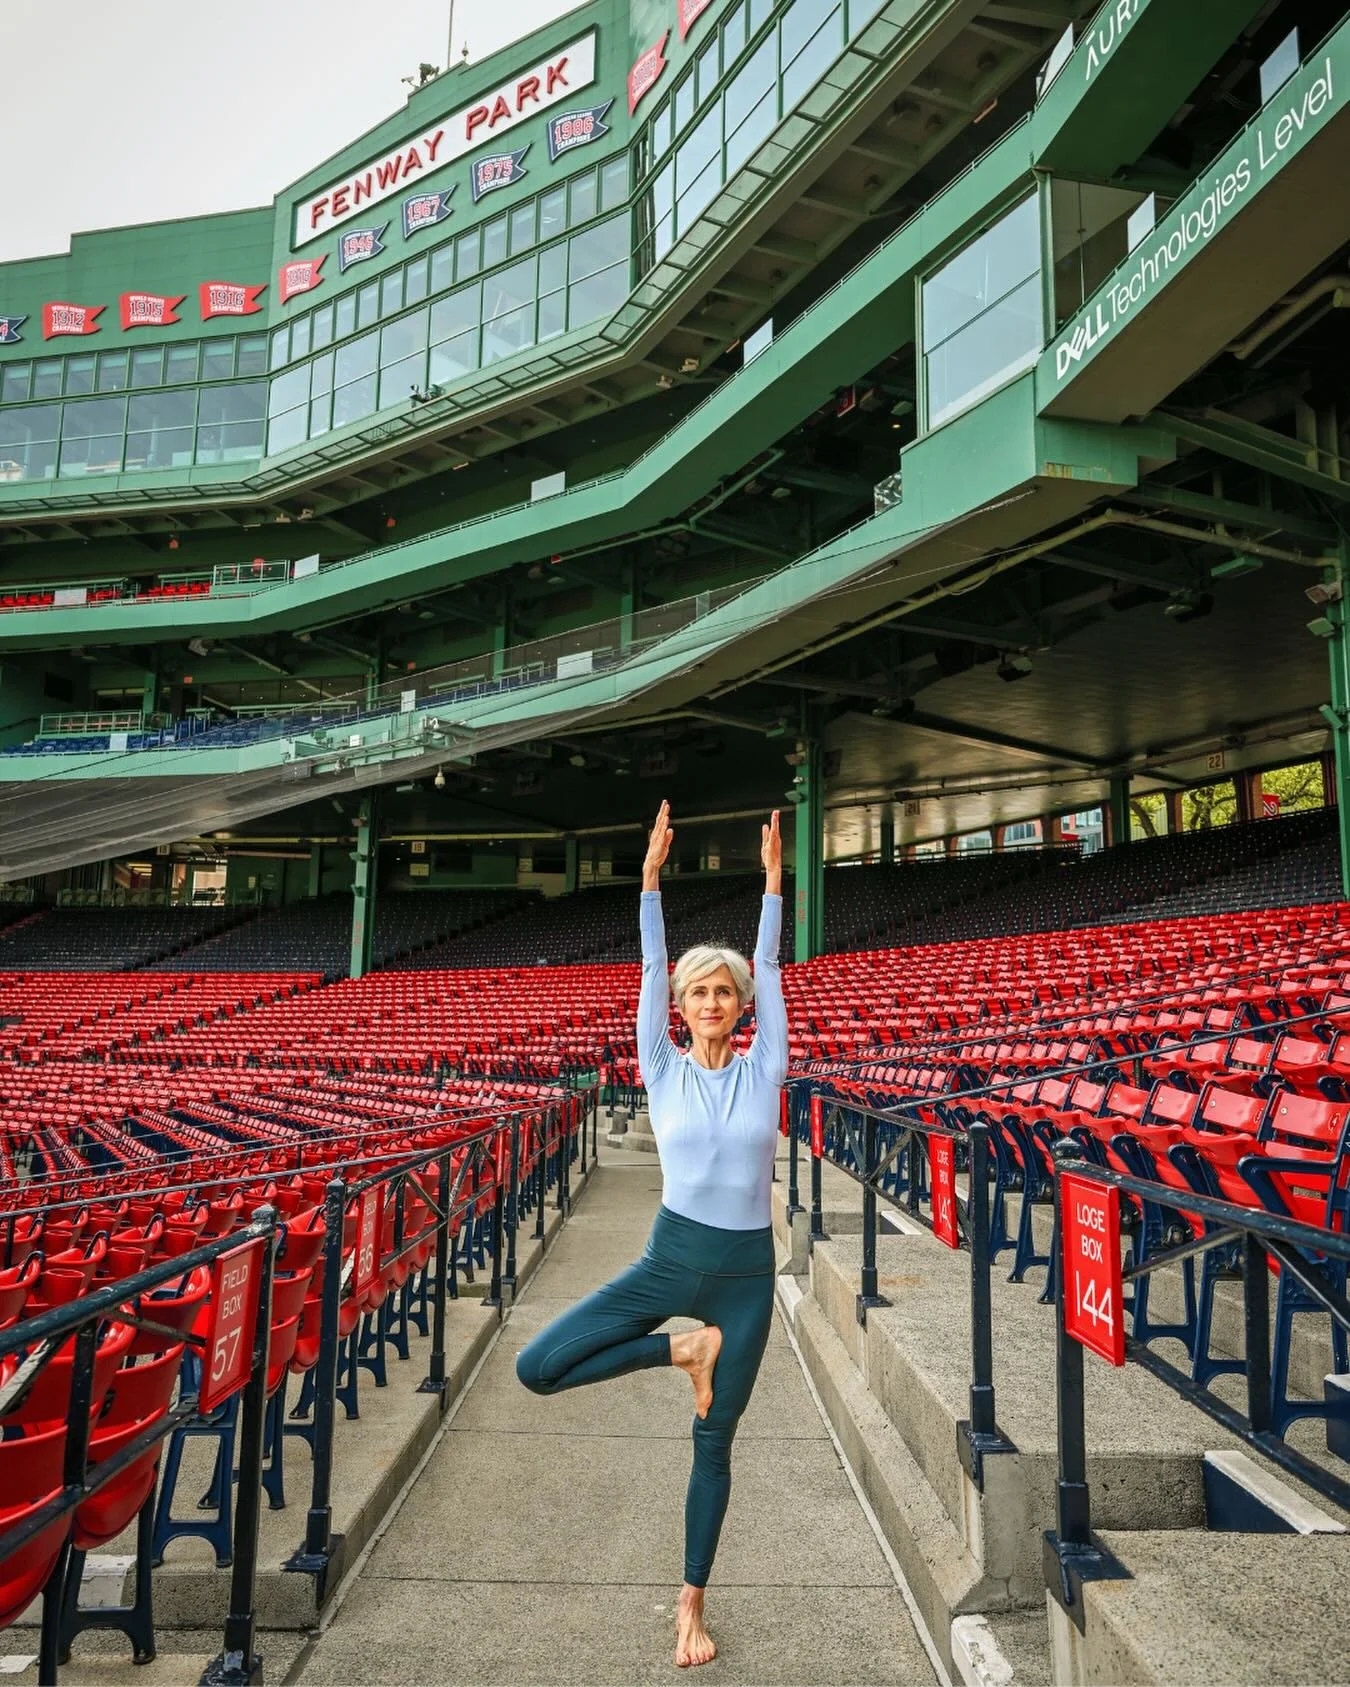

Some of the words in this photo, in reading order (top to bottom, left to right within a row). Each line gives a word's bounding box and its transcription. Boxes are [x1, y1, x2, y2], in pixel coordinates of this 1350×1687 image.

[309, 130, 444, 229] FENWAY
[465, 57, 570, 141] PARK
[554, 116, 595, 145] 1986
[477, 159, 513, 186] 1975
[407, 198, 441, 224] 1967
[1056, 311, 1110, 381] DELL
[1106, 158, 1252, 323] Technologies
[1258, 58, 1334, 171] Level
[130, 300, 163, 318] 1915
[210, 290, 245, 308] 1916
[52, 310, 85, 328] 1912
[1208, 755, 1221, 769] 22
[1076, 1203, 1106, 1233] LOGE
[1080, 1234, 1104, 1264] BOX
[222, 1264, 249, 1293] FIELD
[222, 1294, 242, 1320] BOX
[1075, 1270, 1114, 1337] 144
[211, 1326, 243, 1382] 57
